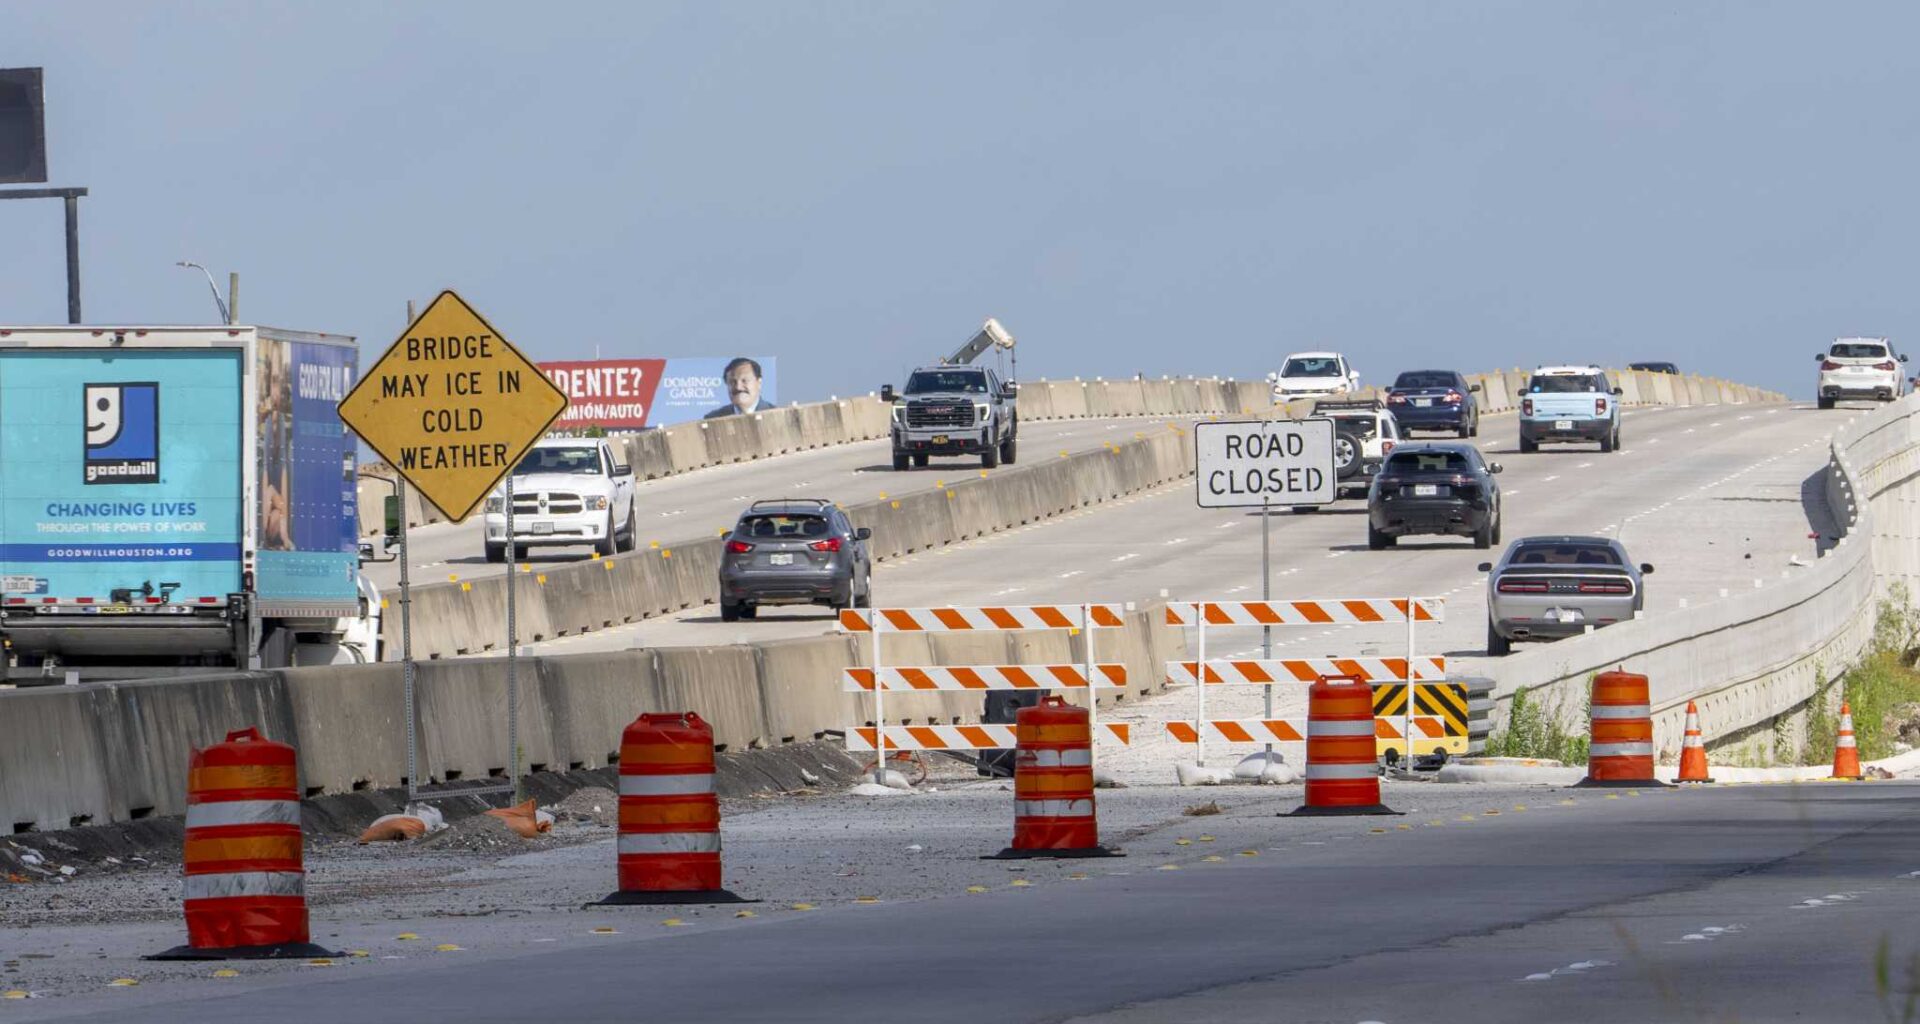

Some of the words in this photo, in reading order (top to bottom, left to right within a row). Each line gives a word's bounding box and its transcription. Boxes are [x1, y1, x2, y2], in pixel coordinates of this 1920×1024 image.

[407, 335, 492, 361] BRIDGE
[300, 362, 318, 399] GOOD
[382, 374, 429, 398] MAY
[446, 372, 482, 396] ICE
[499, 370, 520, 394] IN
[664, 376, 721, 388] DOMINGO
[422, 408, 483, 433] COLD
[401, 443, 507, 470] WEATHER
[1226, 433, 1303, 459] ROAD
[87, 461, 156, 481] goodwill
[1209, 468, 1323, 495] CLOSED
[47, 502, 146, 517] CHANGING
[151, 502, 197, 517] LIVES
[36, 523, 89, 534] THROUGH
[91, 523, 111, 533] THE
[113, 522, 151, 533] POWER
[154, 522, 170, 533] OF
[172, 522, 207, 532] WORK
[47, 548, 193, 558] GOODWILLHOUSTON.ORG
